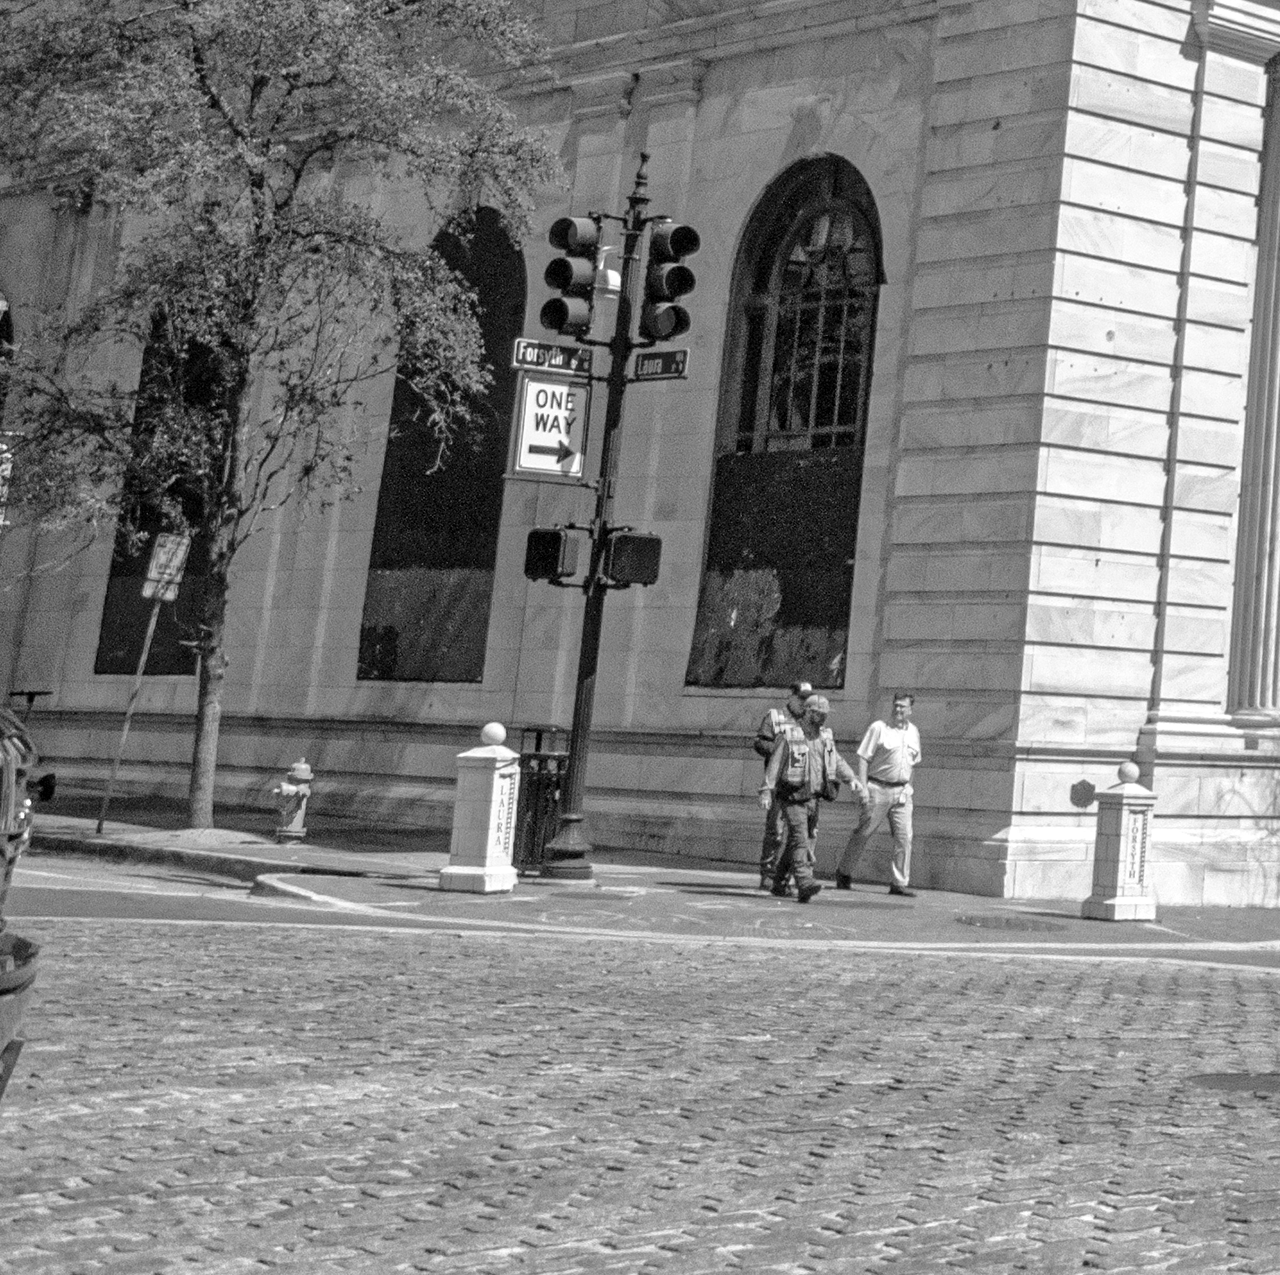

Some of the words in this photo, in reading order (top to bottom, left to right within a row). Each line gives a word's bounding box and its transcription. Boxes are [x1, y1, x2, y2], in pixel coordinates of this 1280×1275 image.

[518, 342, 564, 368] Forsyth
[535, 389, 576, 412] ONE
[534, 412, 577, 435] WAY
[495, 785, 506, 846] LAURA
[1128, 817, 1139, 879] FORSYTH
